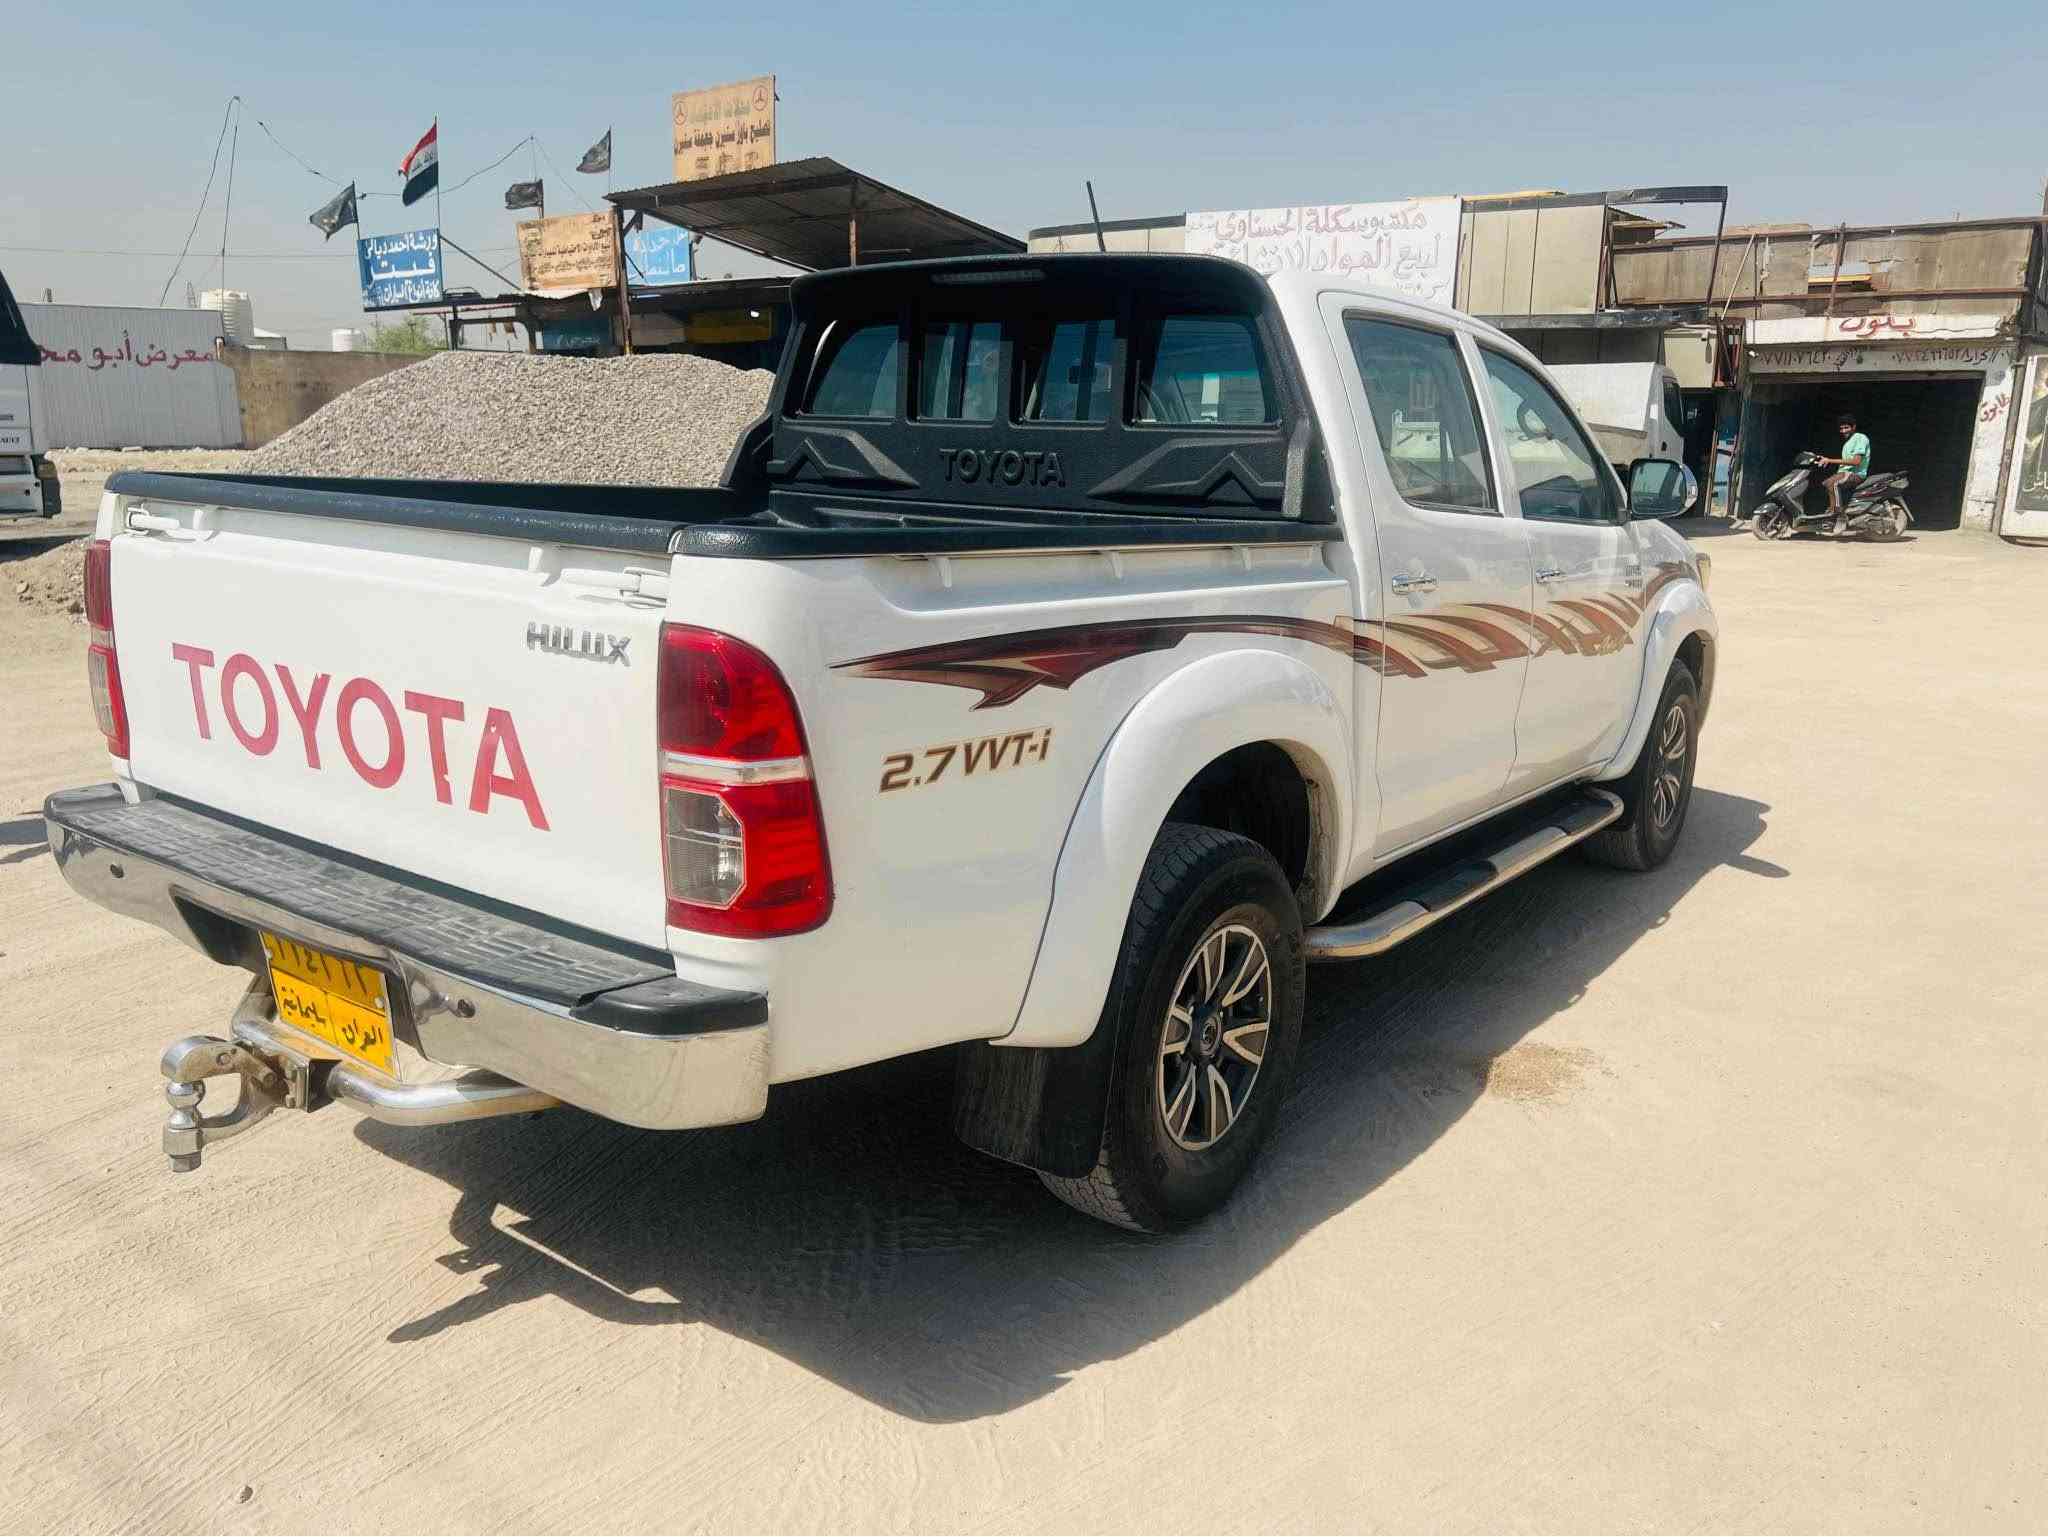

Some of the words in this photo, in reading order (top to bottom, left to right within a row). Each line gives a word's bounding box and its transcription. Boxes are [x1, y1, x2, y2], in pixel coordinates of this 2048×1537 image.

[135, 343, 215, 370] معرض
[939, 448, 1066, 489] TOYOTA
[527, 621, 632, 667] HILUX
[172, 642, 551, 832] TOYOTA
[878, 746, 960, 793] 2.7
